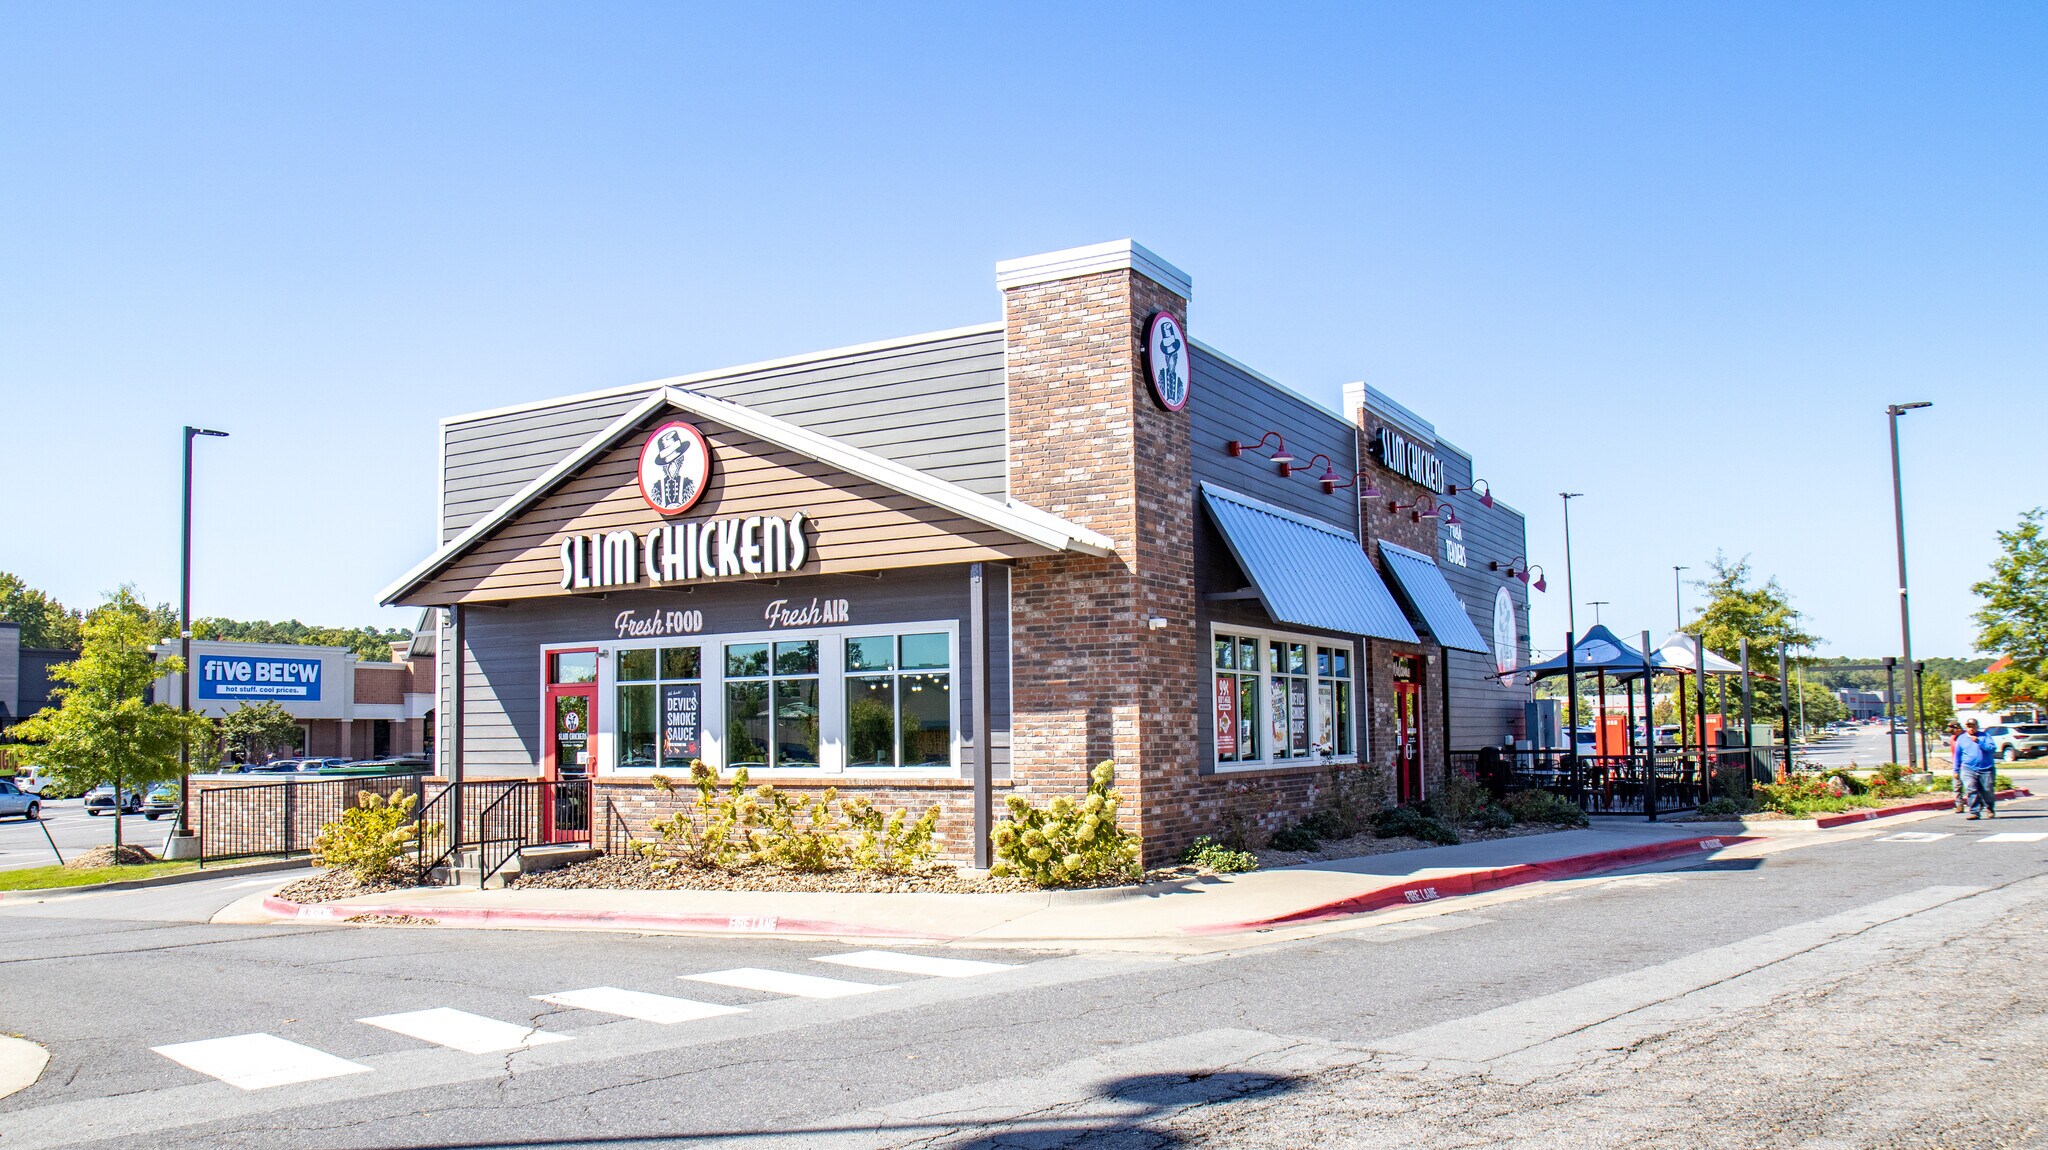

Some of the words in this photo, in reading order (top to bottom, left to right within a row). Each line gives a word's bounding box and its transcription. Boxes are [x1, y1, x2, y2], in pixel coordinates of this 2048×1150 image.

[1382, 428, 1406, 477] SLIM
[1407, 442, 1444, 495] CHICKENS
[560, 529, 638, 590] SLIM
[645, 511, 808, 583] CHICKENS
[614, 609, 665, 639] Fresh
[665, 610, 703, 634] FOOD
[764, 597, 823, 629] Fresh
[822, 598, 850, 624] AIR
[204, 660, 252, 682] five
[667, 697, 697, 711] DEVIL'S
[667, 712, 697, 726] SMOKE
[667, 727, 695, 741] SAUCE
[1404, 889, 1422, 903] FIRE
